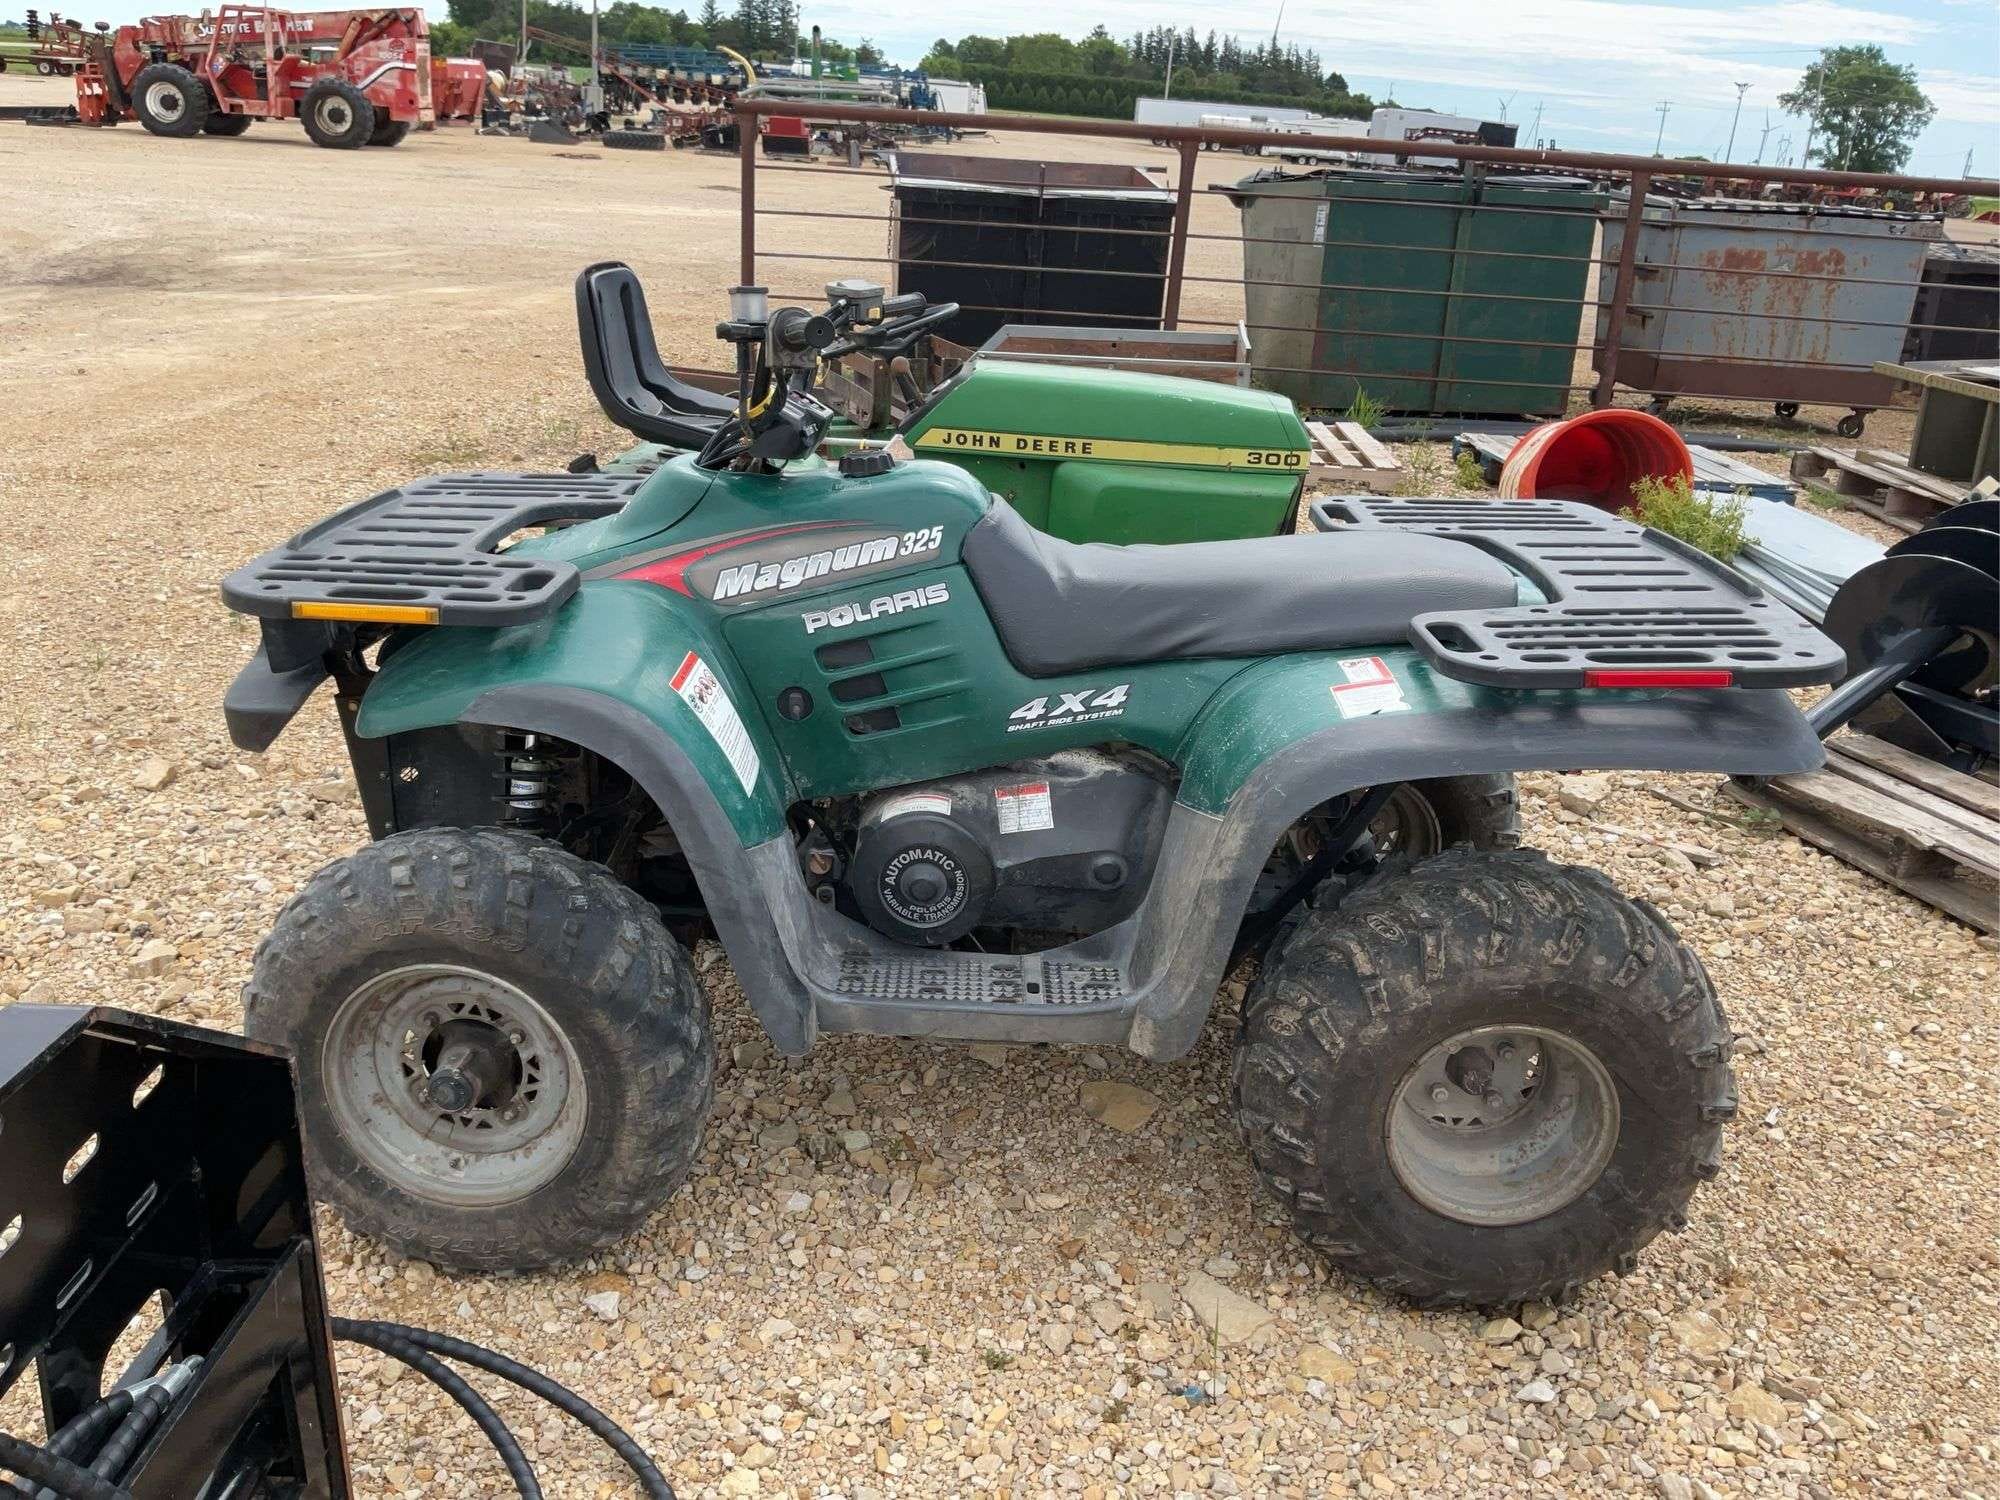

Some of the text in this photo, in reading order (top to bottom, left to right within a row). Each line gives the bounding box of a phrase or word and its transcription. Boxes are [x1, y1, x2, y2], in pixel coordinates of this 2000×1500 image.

[943, 432, 1301, 467] JOHN DEERE 300
[712, 525, 945, 601] Magnum 325
[801, 582, 950, 635] POLARIS
[1006, 720, 1046, 733] SHAFT
[1076, 707, 1125, 722] SYSTEM
[1009, 684, 1131, 720] 4X4
[884, 848, 955, 886] AUTOMATIC
[883, 870, 966, 921] VARIABLE TRANSMISSION
[909, 895, 952, 914] POLARIS
